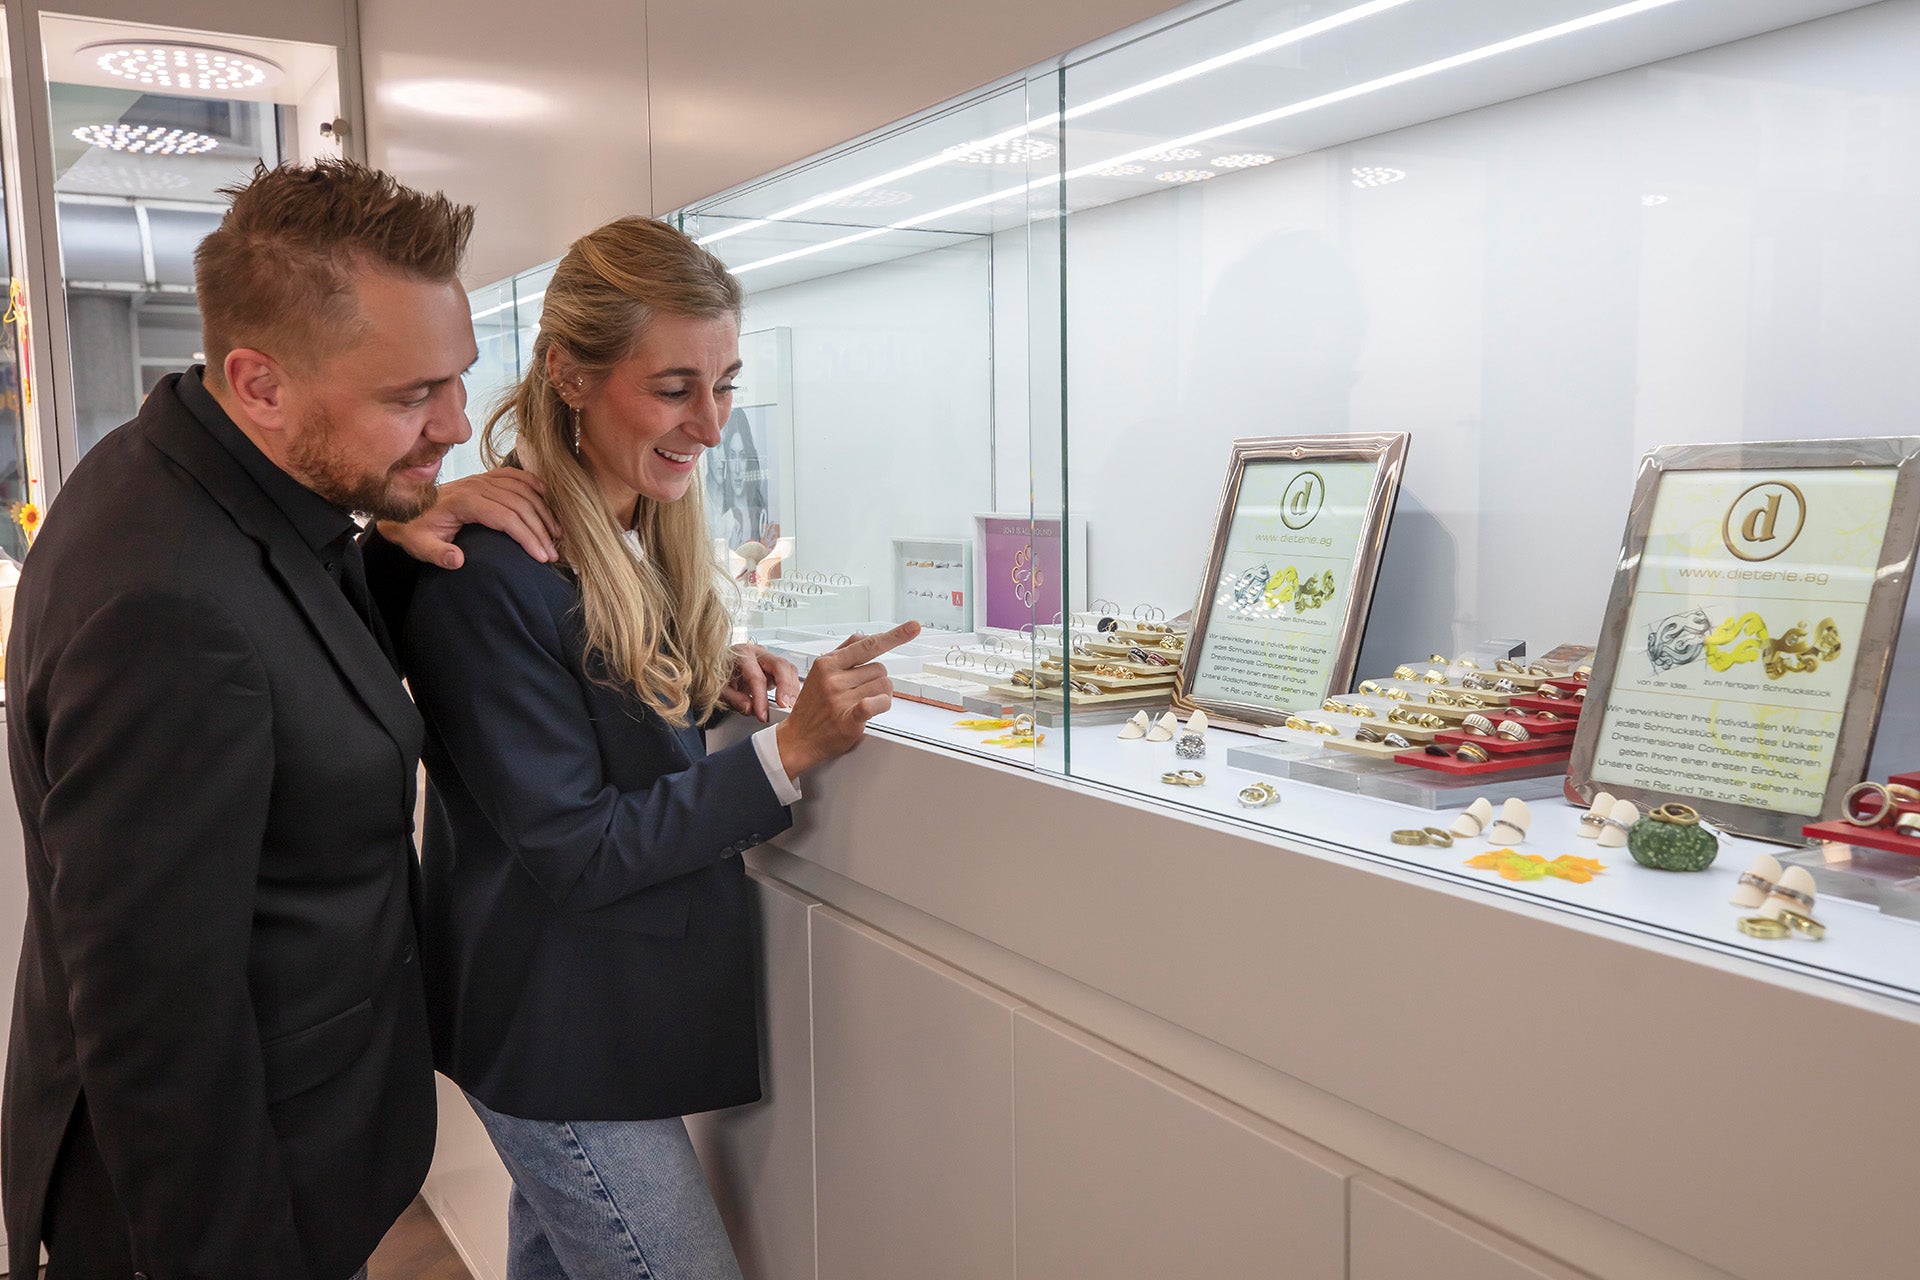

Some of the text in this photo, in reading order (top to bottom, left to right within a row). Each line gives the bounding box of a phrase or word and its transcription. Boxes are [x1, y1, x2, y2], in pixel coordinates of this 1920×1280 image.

[1742, 493, 1782, 542] d
[1255, 533, 1333, 547] www.dieterle.ag
[1679, 568, 1829, 586] www.dieterle.ag
[1725, 680, 1759, 690] fertigen
[1762, 684, 1831, 697] Schmuckstück
[1606, 704, 1835, 738] Wir verwirklichen Ihre individuellen Wünsche
[1614, 720, 1823, 752] jedes Schmuckstück ein echtes Unikat!
[1611, 732, 1821, 767] Dreidimensionale Computeranimationen
[1618, 748, 1803, 780] geben Ihnen einen ersten Eindruck.
[1598, 758, 1824, 798] Unsere Goldschmiedemeister stehen Ihnen
[1633, 779, 1650, 787] mit
[1653, 780, 1671, 790] Rat
[1675, 786, 1693, 794] und
[1698, 787, 1714, 797] Tat
